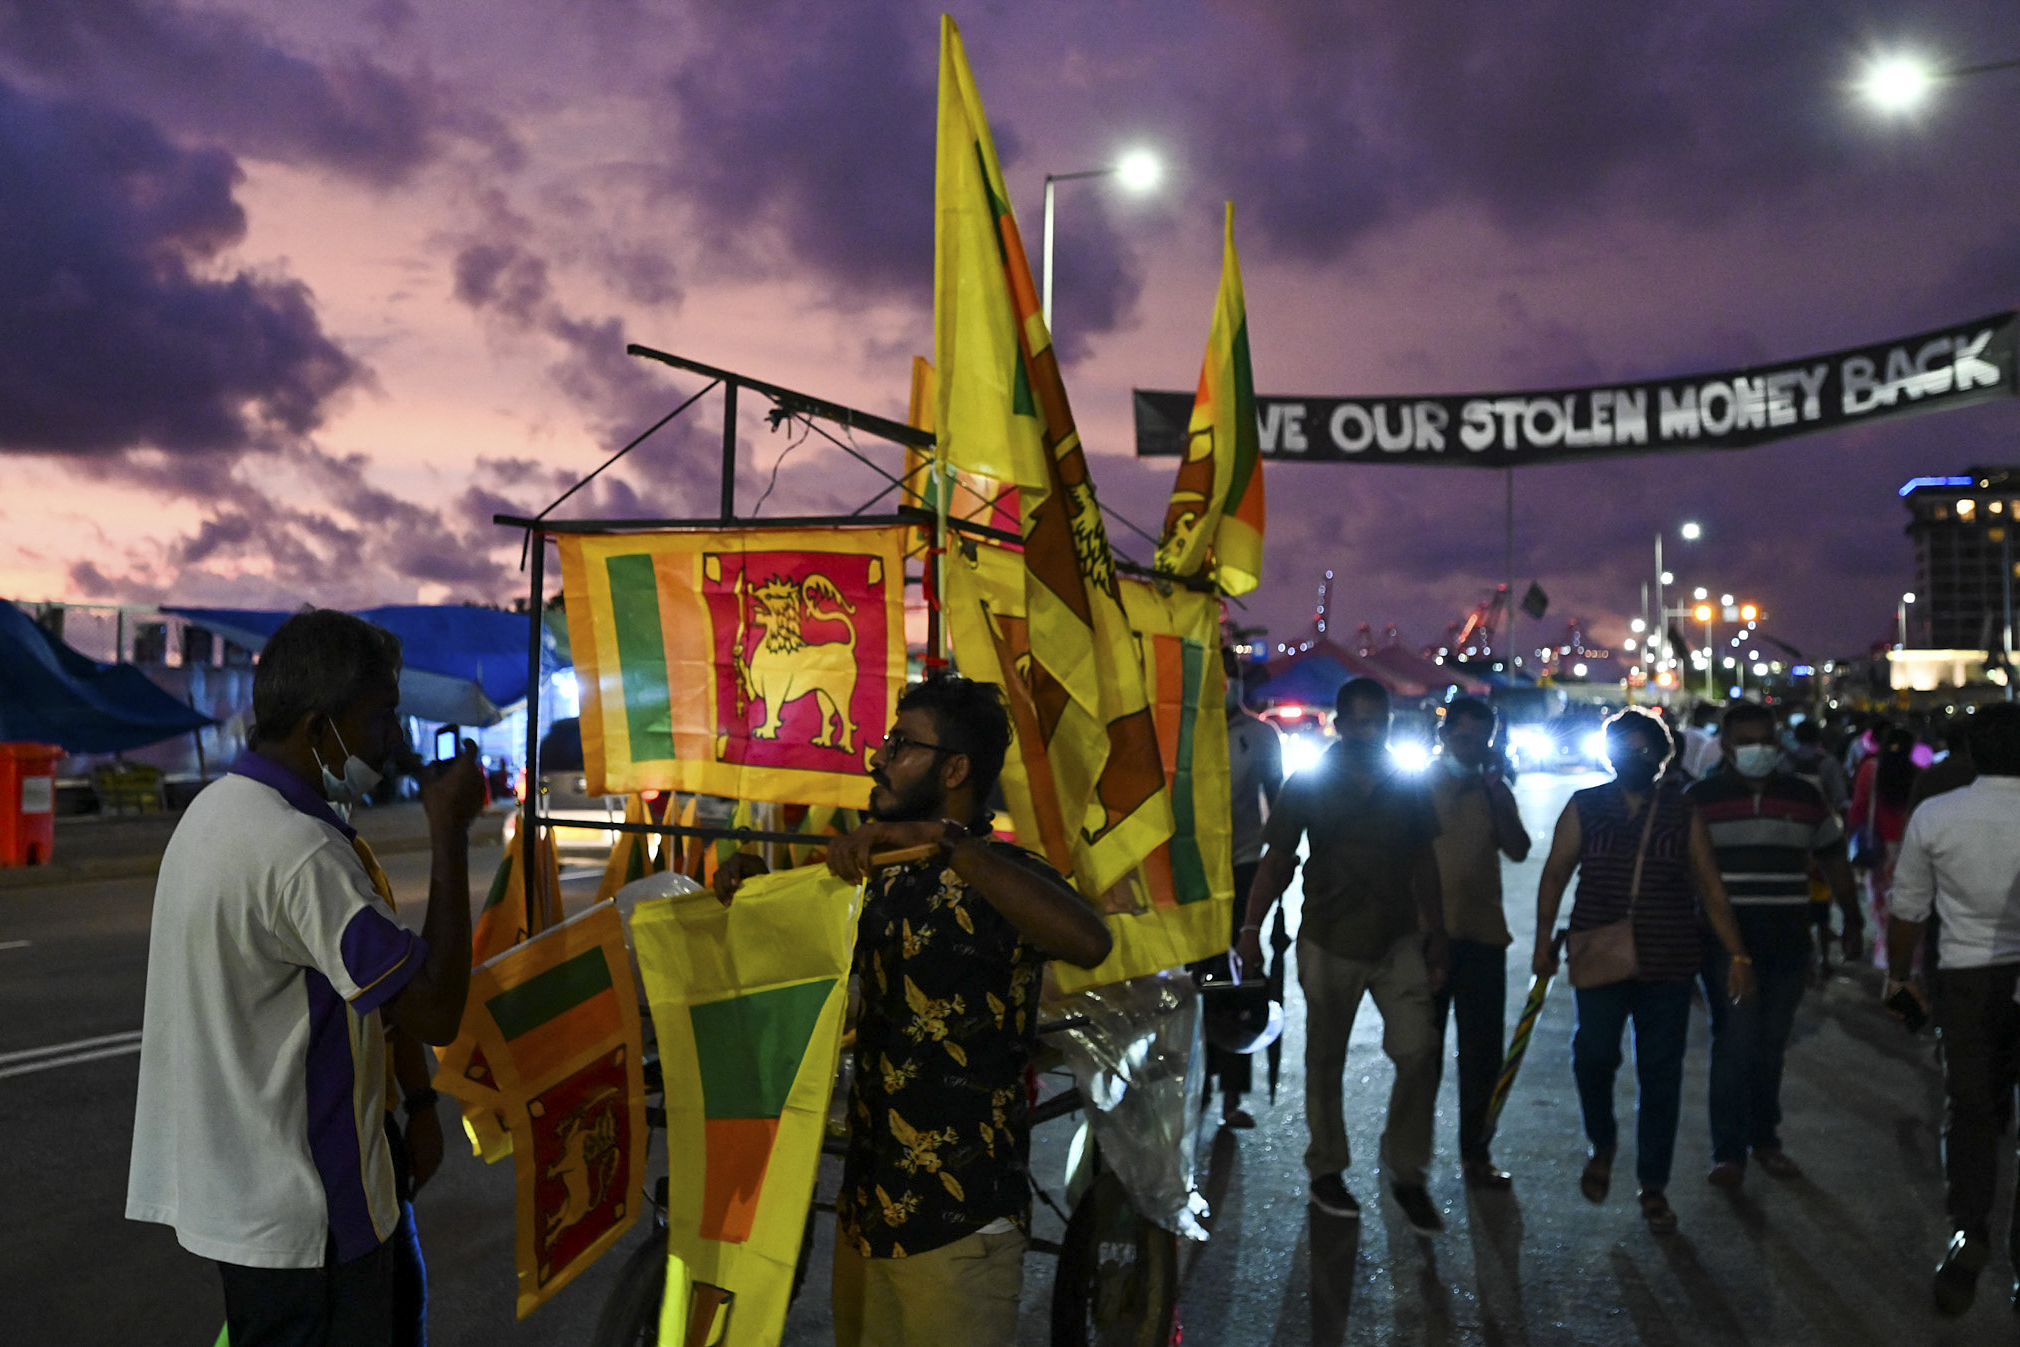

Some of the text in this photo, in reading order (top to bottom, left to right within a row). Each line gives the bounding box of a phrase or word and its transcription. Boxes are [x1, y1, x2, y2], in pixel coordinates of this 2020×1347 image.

[1256, 328, 2001, 453] VE OUR STOLEN MONEY BACK
